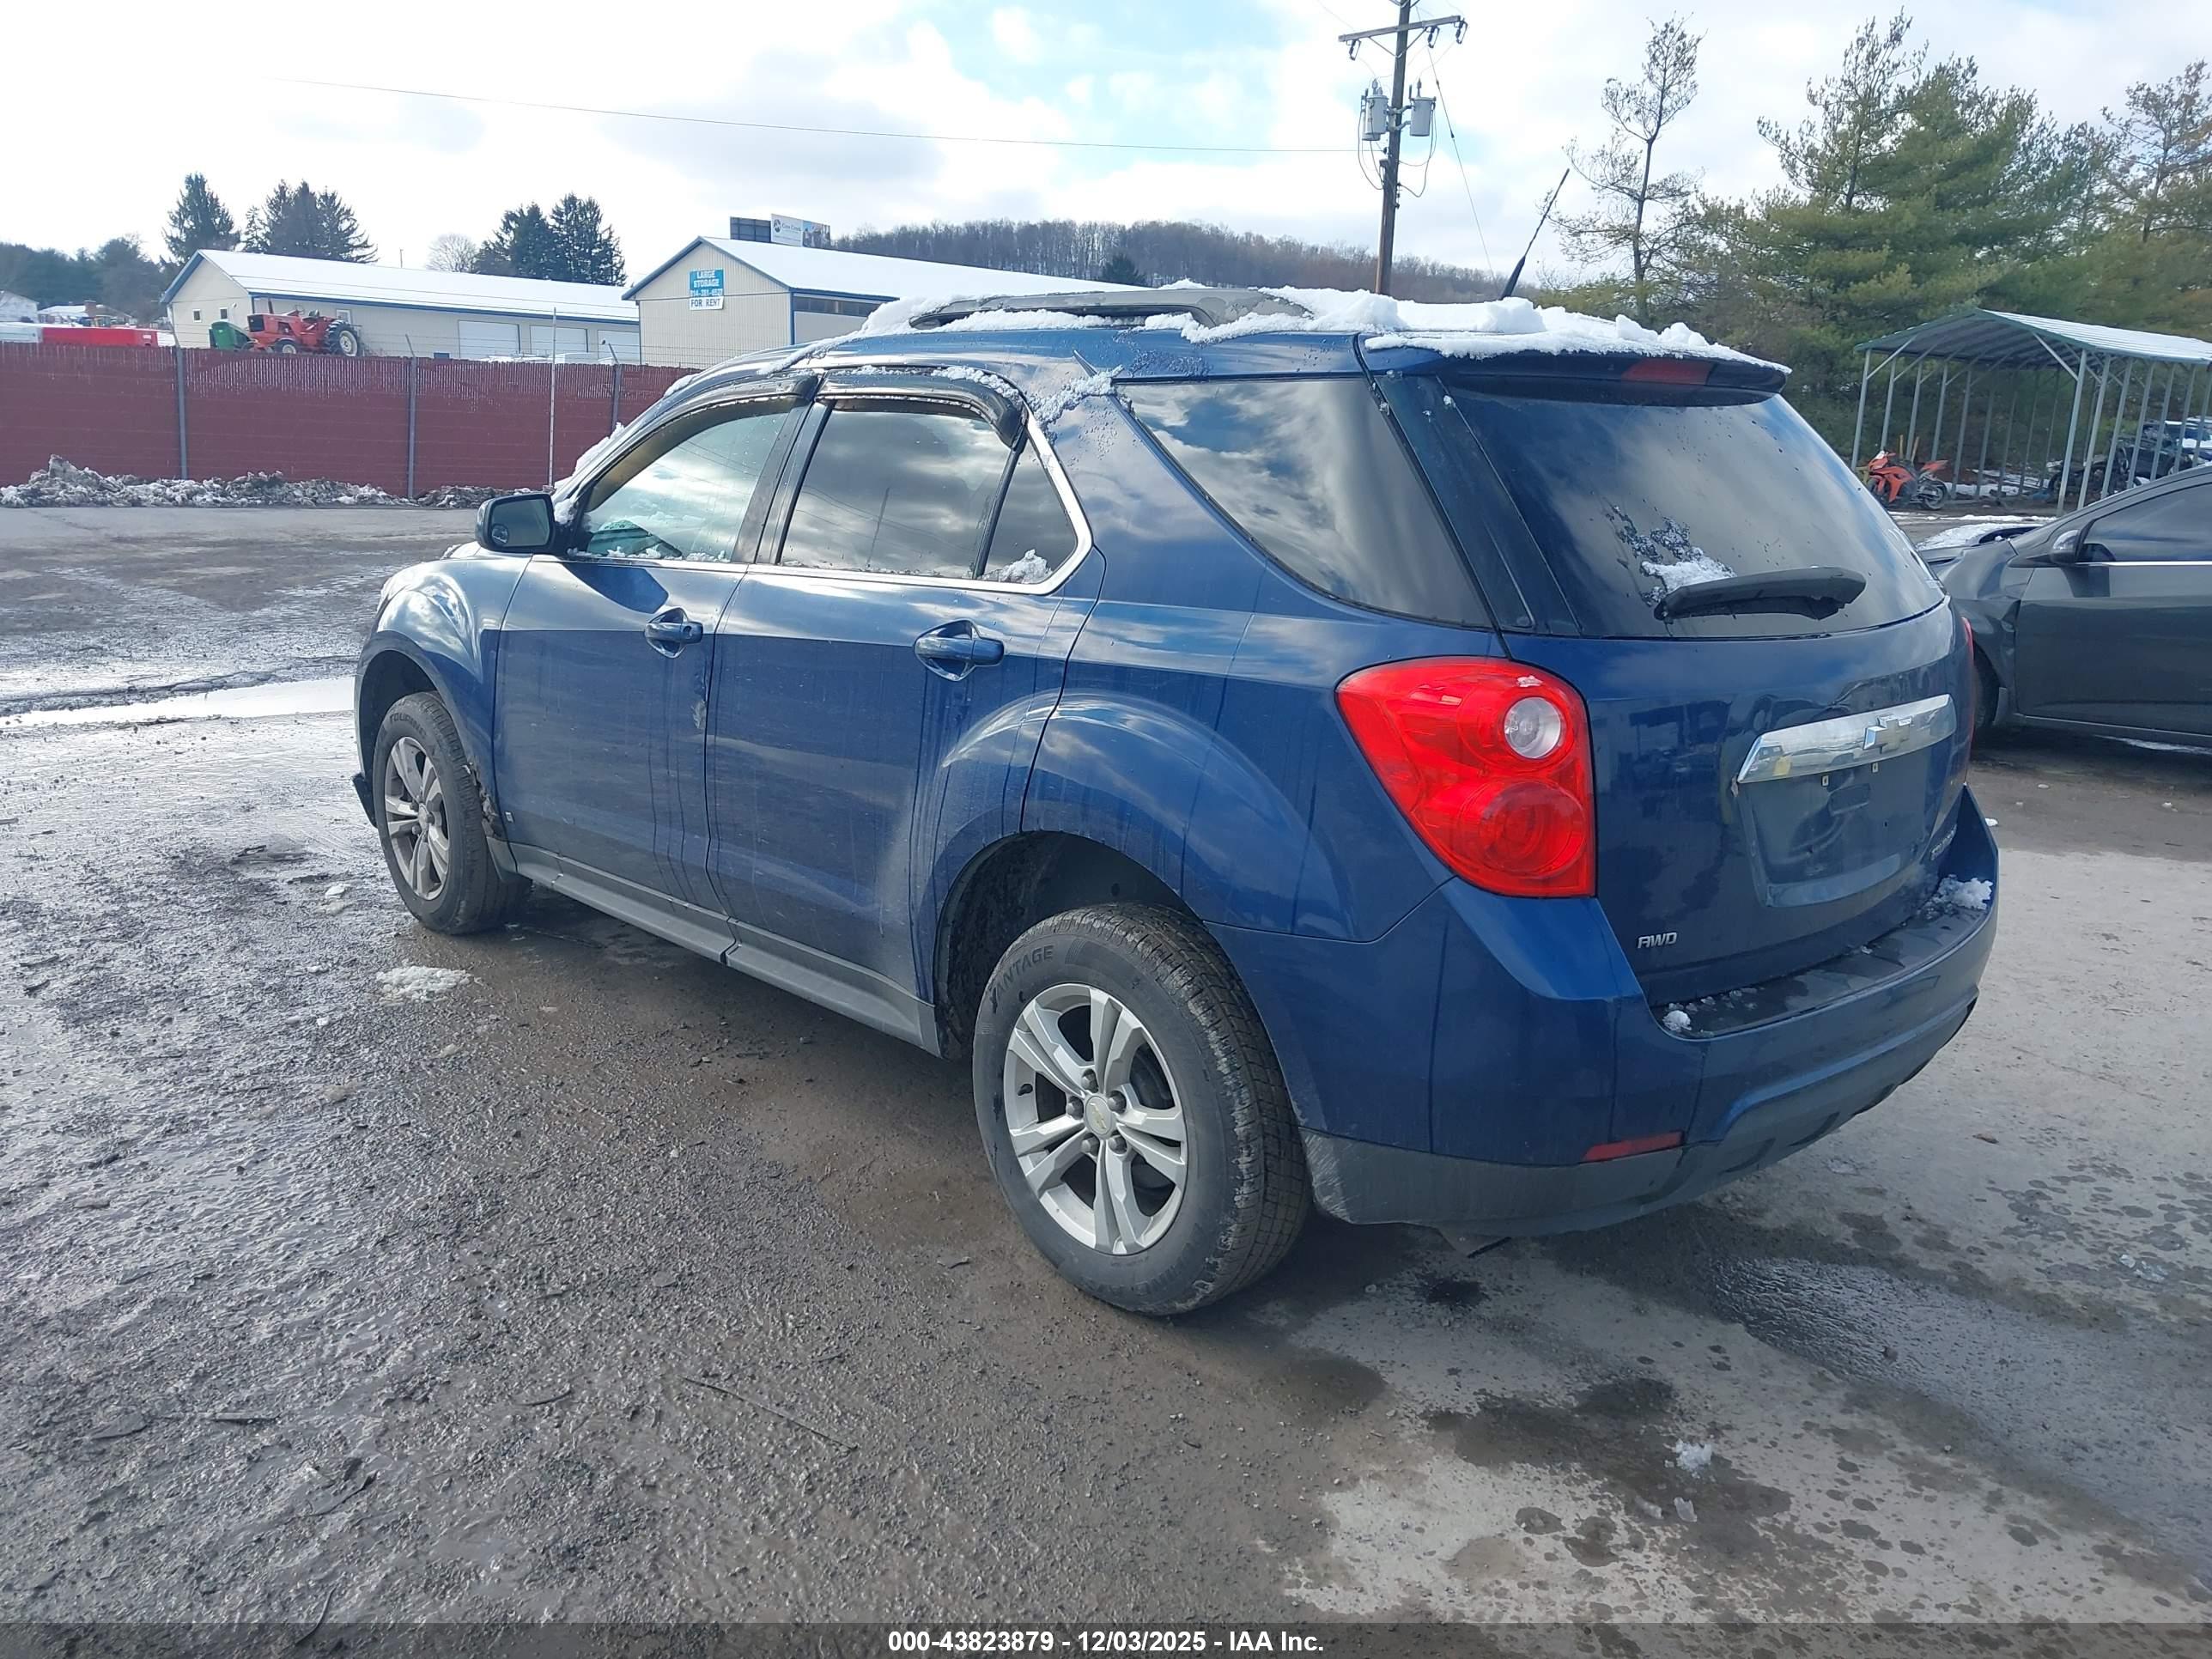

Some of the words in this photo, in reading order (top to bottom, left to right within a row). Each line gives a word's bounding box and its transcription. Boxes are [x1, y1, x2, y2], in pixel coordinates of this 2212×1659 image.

[696, 270, 715, 279] LARGE
[694, 278, 720, 288] STORAGE
[690, 299, 702, 307] FOR
[706, 298, 720, 307] RENT
[1638, 932, 1677, 949] AWD
